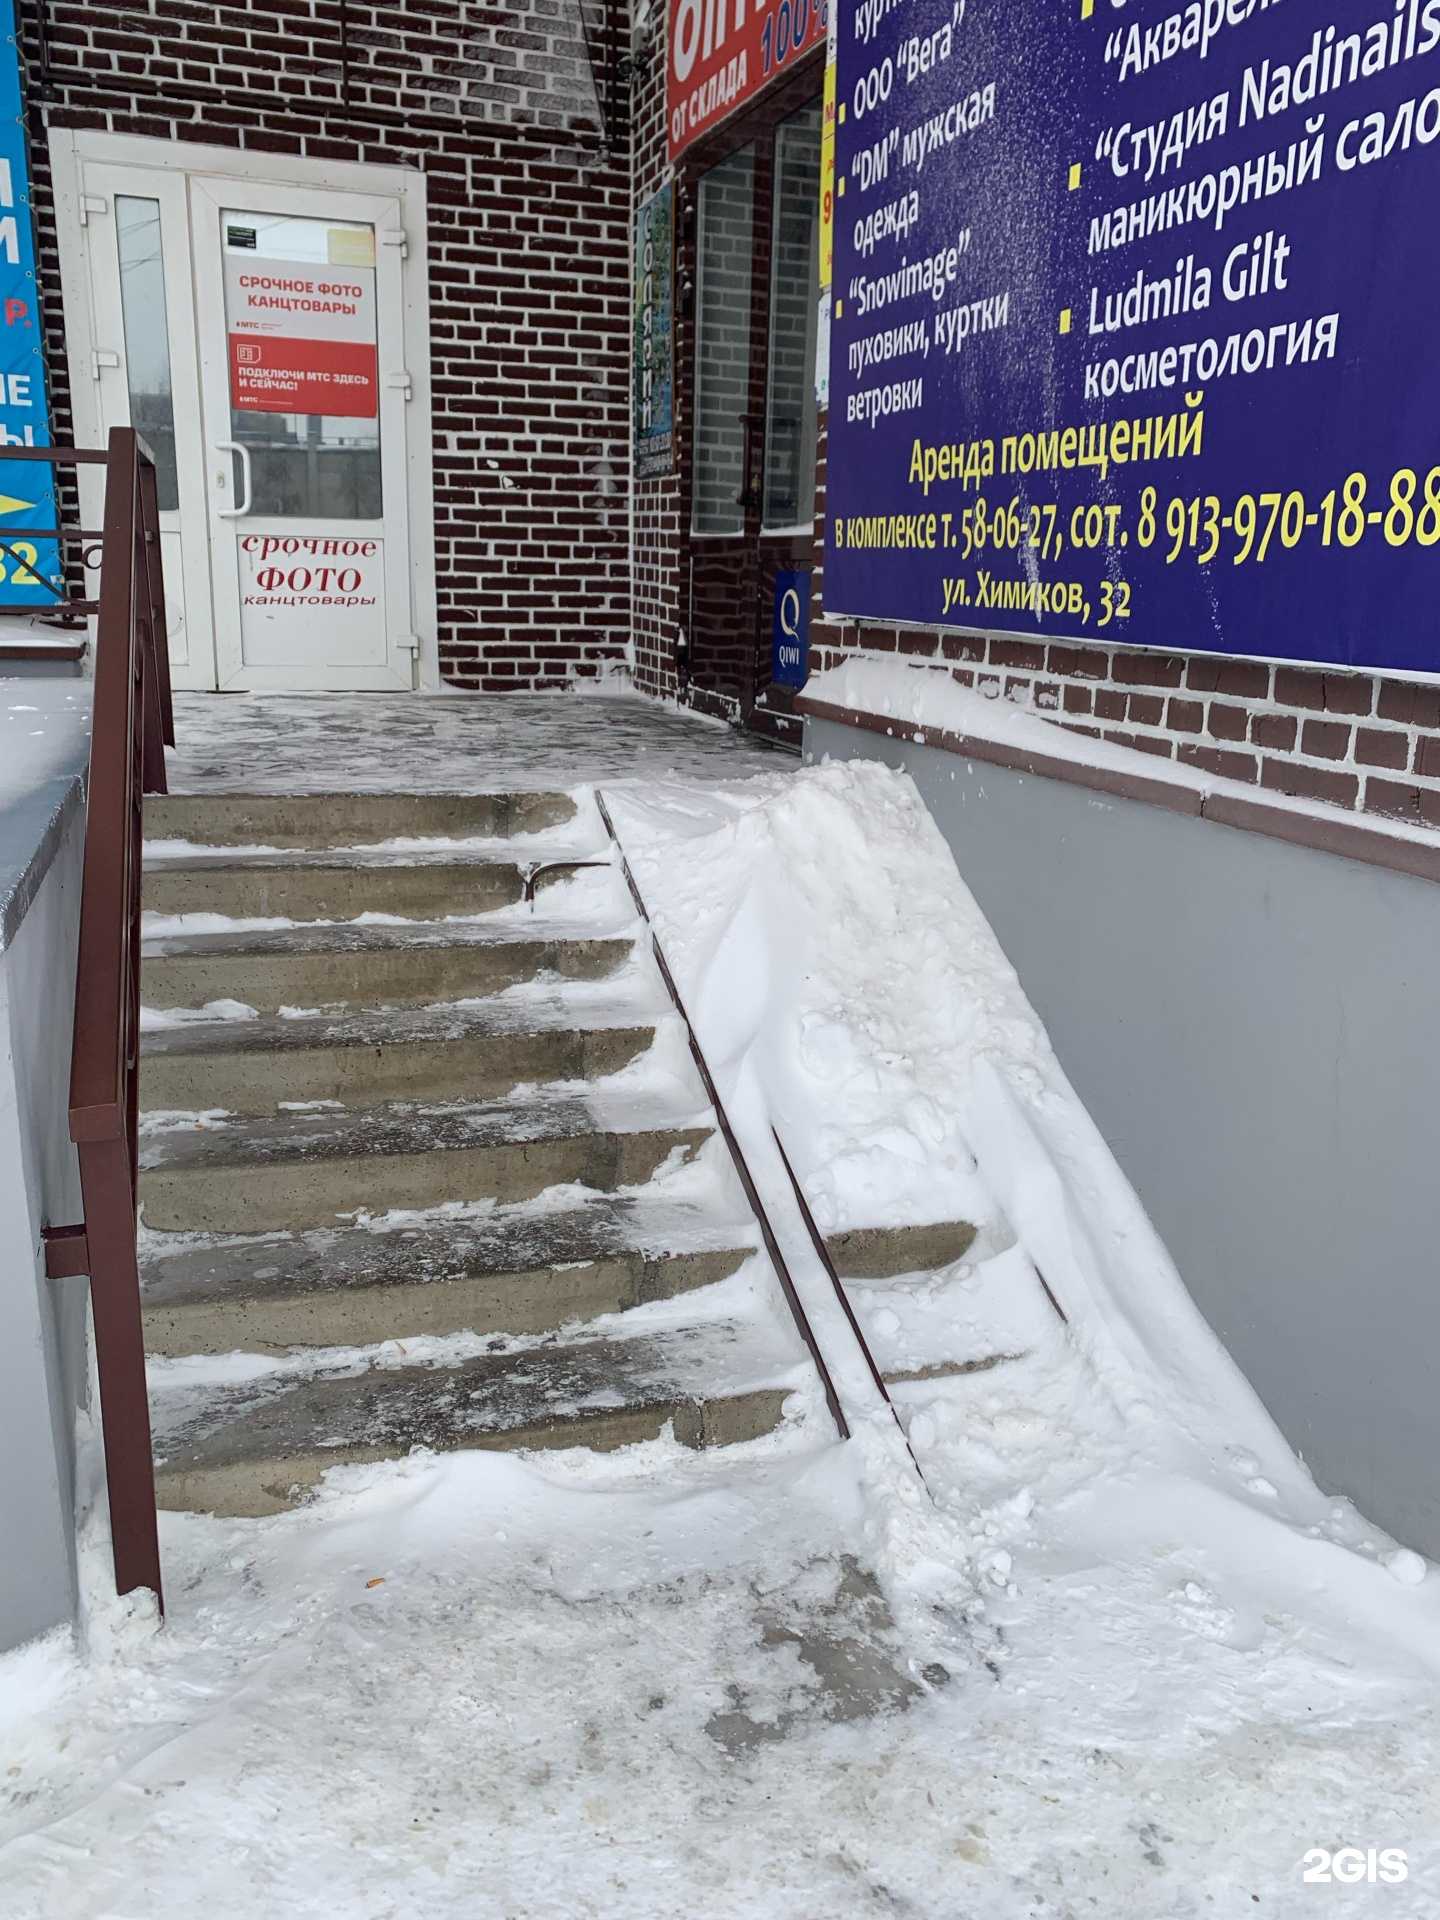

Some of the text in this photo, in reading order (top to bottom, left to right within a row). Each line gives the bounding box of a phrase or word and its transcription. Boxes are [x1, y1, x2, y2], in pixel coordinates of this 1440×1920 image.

[854, 57, 893, 119] ООО
[1239, 0, 1440, 127] Nadinails
[672, 49, 747, 143] ОТ СКЛАДА
[902, 82, 996, 172] мужская
[1088, 113, 1325, 255] маникюрный
[854, 190, 919, 257] одежда
[239, 275, 363, 298] СРОЧНОЕ ФОТО
[247, 295, 357, 315] КАНЦТОВАРЫ
[1089, 231, 1291, 335] Ludmila Gilt
[848, 292, 1010, 379] пуховики, куртки
[1084, 313, 1340, 400] косметология
[238, 366, 369, 385] ПОДКЛЮЧИ МТС ЗДЕСЬ
[239, 378, 298, 391] И СЕЙЧАС!
[847, 377, 923, 429] ветровки
[908, 391, 1205, 496] Аренда помещений
[835, 518, 843, 548] в
[846, 514, 937, 549] комплексе
[941, 513, 957, 548] т.
[1070, 504, 1129, 549] сот.
[1137, 486, 1157, 548] 8
[1166, 466, 1440, 566] 913-970-18-88
[241, 535, 377, 561] срочное
[244, 596, 376, 608] канцтовары
[256, 567, 362, 592] ФОТО
[942, 571, 1132, 627] ул. Химиков, 32
[778, 645, 800, 668] QIWI
